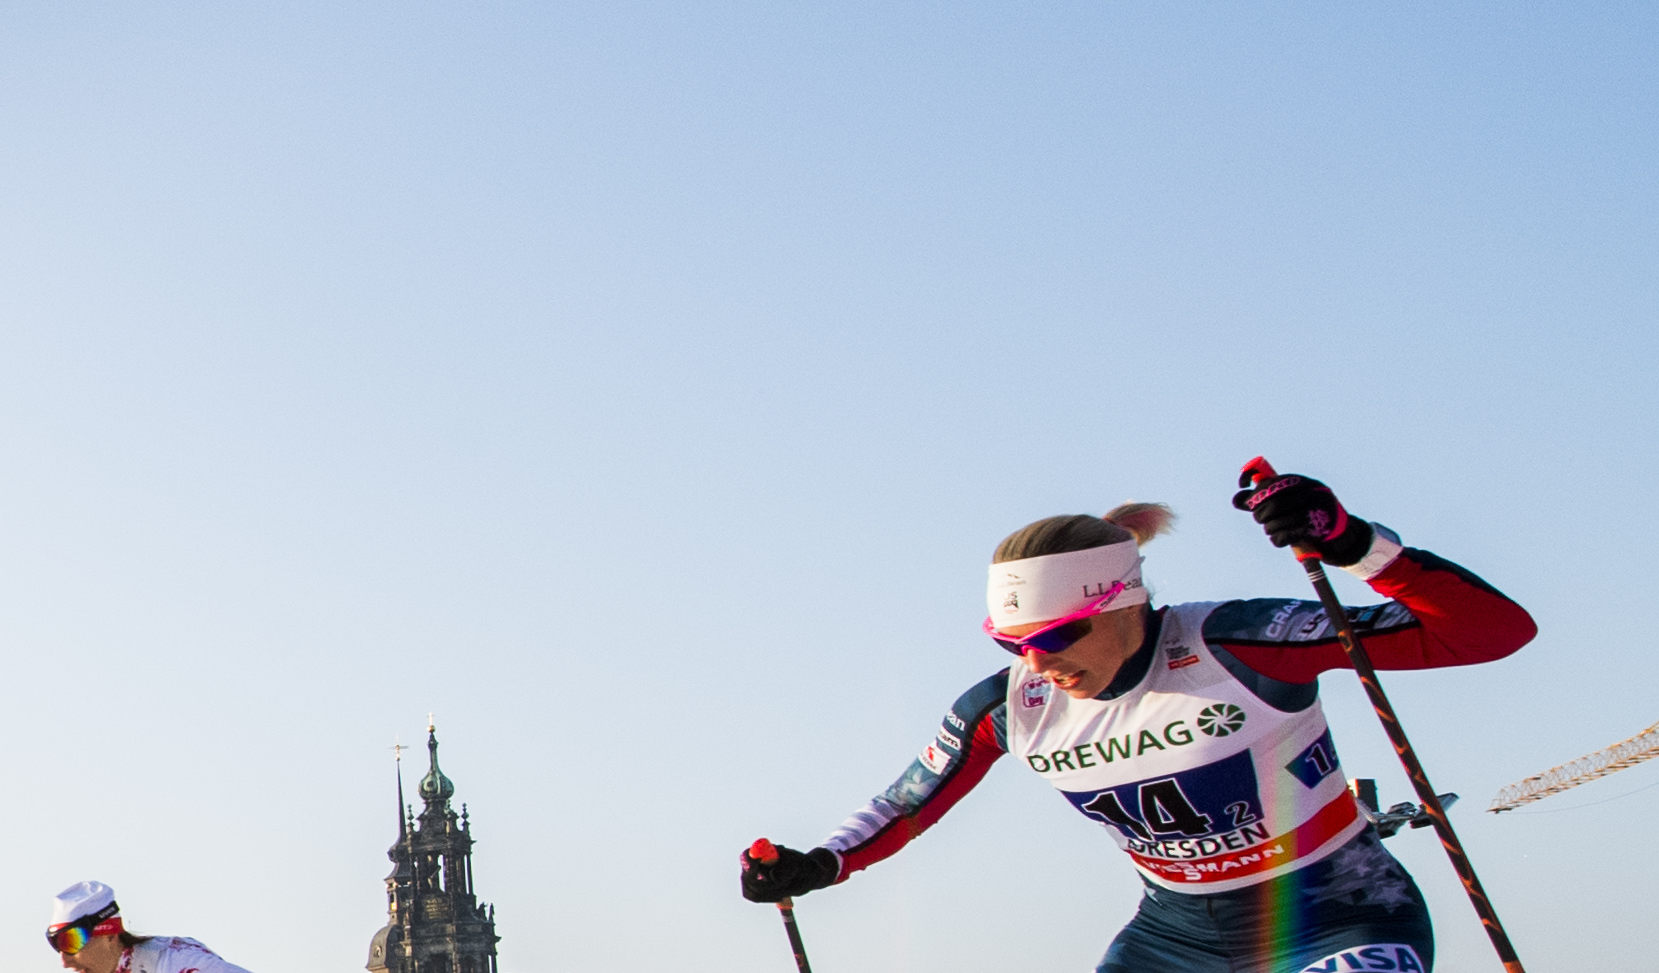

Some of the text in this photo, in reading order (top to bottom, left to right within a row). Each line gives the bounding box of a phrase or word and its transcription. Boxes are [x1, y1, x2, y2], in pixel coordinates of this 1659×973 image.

[1027, 720, 1194, 773] DREWAG
[1081, 777, 1256, 842] 14 2
